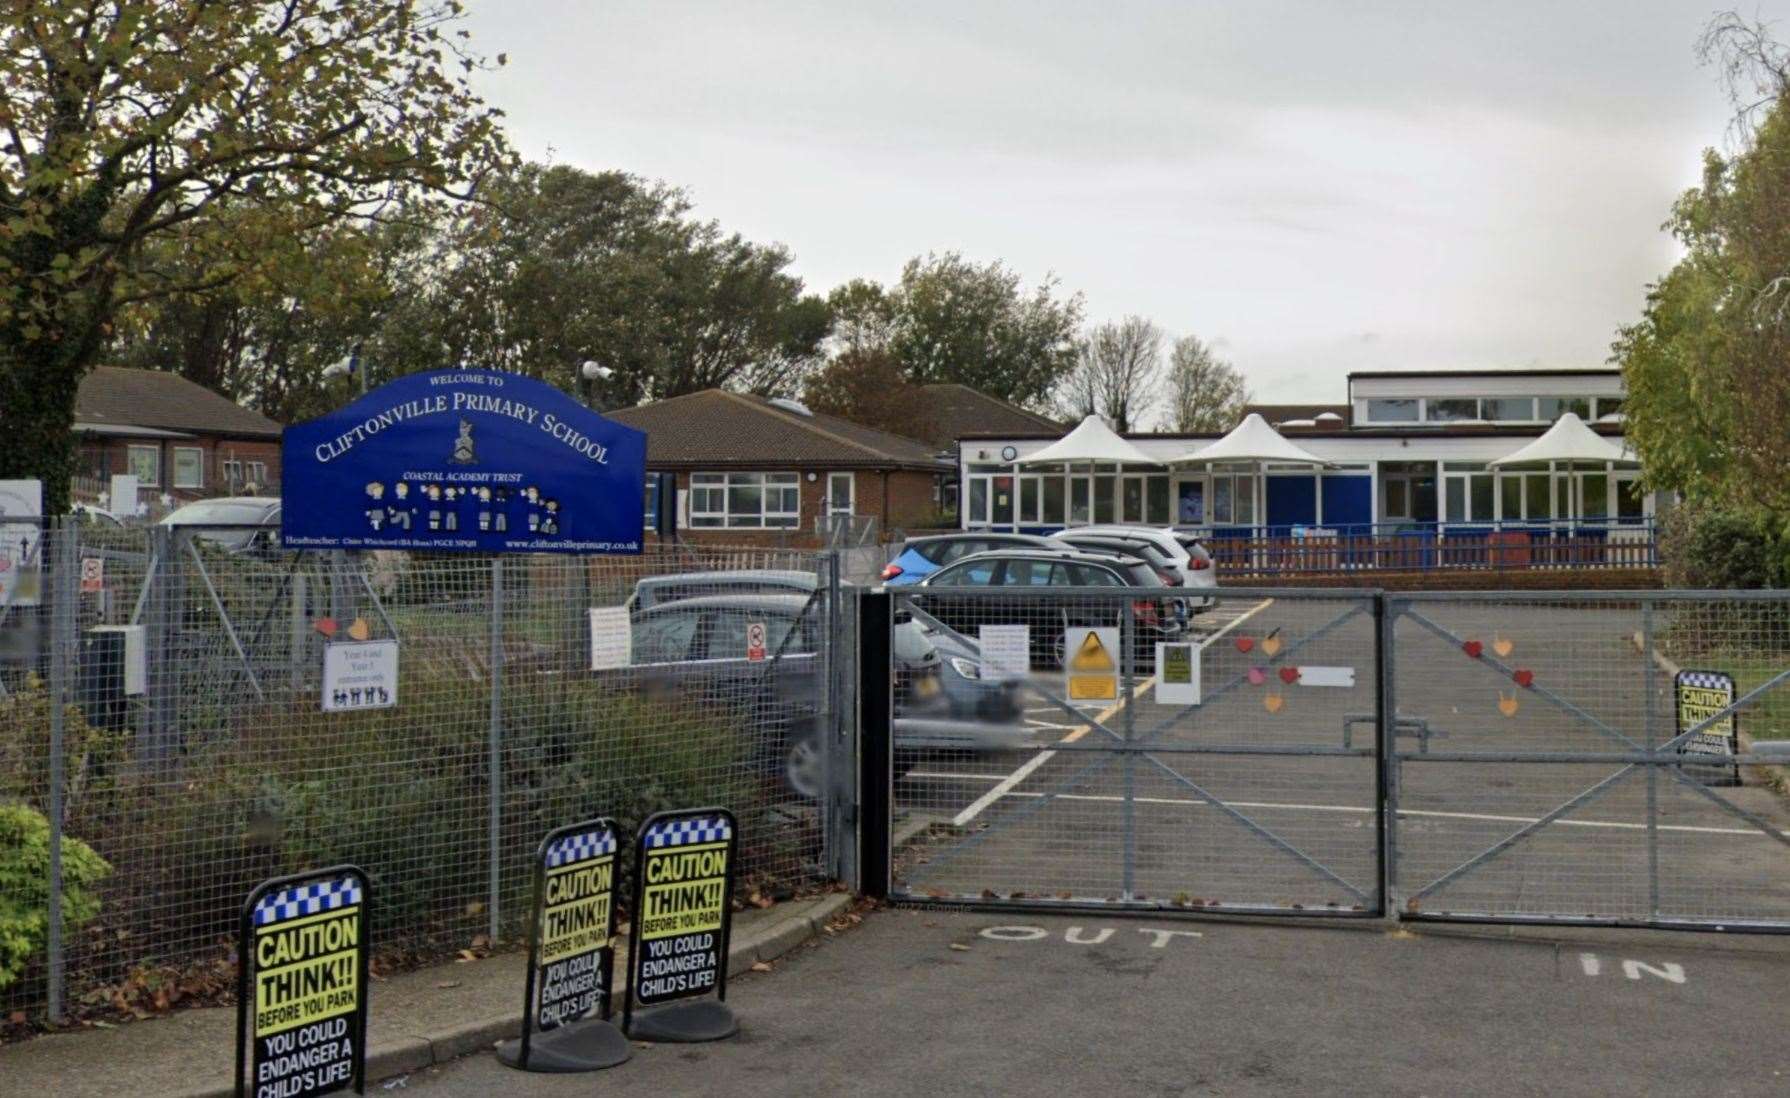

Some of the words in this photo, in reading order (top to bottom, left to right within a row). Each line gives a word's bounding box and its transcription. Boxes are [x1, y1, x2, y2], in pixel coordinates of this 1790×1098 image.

[430, 374, 484, 386] WELCOME
[488, 376, 504, 387] TO
[315, 395, 447, 462] CLIFTONVILLE
[453, 392, 539, 424] PRIMARY
[540, 414, 609, 465] SCHOOL
[403, 471, 445, 481] COASTAL
[446, 472, 490, 482] ACADEMY
[492, 473, 522, 483] TRUST
[506, 539, 639, 551] www.cliftonvilleprimary.co.uk
[1682, 691, 1730, 709] CAUTION
[647, 849, 727, 883] CAUTION
[547, 863, 613, 905] CAUTION
[649, 882, 721, 916] THINK!!
[548, 898, 608, 939] THINK!!
[644, 915, 677, 934] BEFORE
[680, 912, 697, 928] YOU
[699, 911, 721, 926] PARK
[257, 915, 358, 968] CAUTION
[649, 940, 673, 958] YOU
[674, 933, 714, 954] COULD
[977, 925, 1203, 949] OUT
[262, 956, 354, 1007] THINK!!
[547, 961, 568, 982] YOU
[643, 952, 706, 978] ENDANGER
[707, 951, 717, 967] A
[1580, 952, 1686, 984] IN
[542, 972, 594, 1004] ENDANGER
[595, 968, 603, 986] A
[641, 974, 686, 997] CHILD'S
[688, 969, 716, 989] LIFE!
[258, 1003, 301, 1030] BEFORE
[303, 997, 325, 1017] YOU
[327, 990, 354, 1010] PARK
[265, 1031, 296, 1057] YOU
[298, 1018, 347, 1047] COULD
[259, 1042, 339, 1082] ENDANGER
[341, 1038, 353, 1058] A
[257, 1071, 316, 1098] CHILD'S
[318, 1060, 352, 1087] LIFE!
